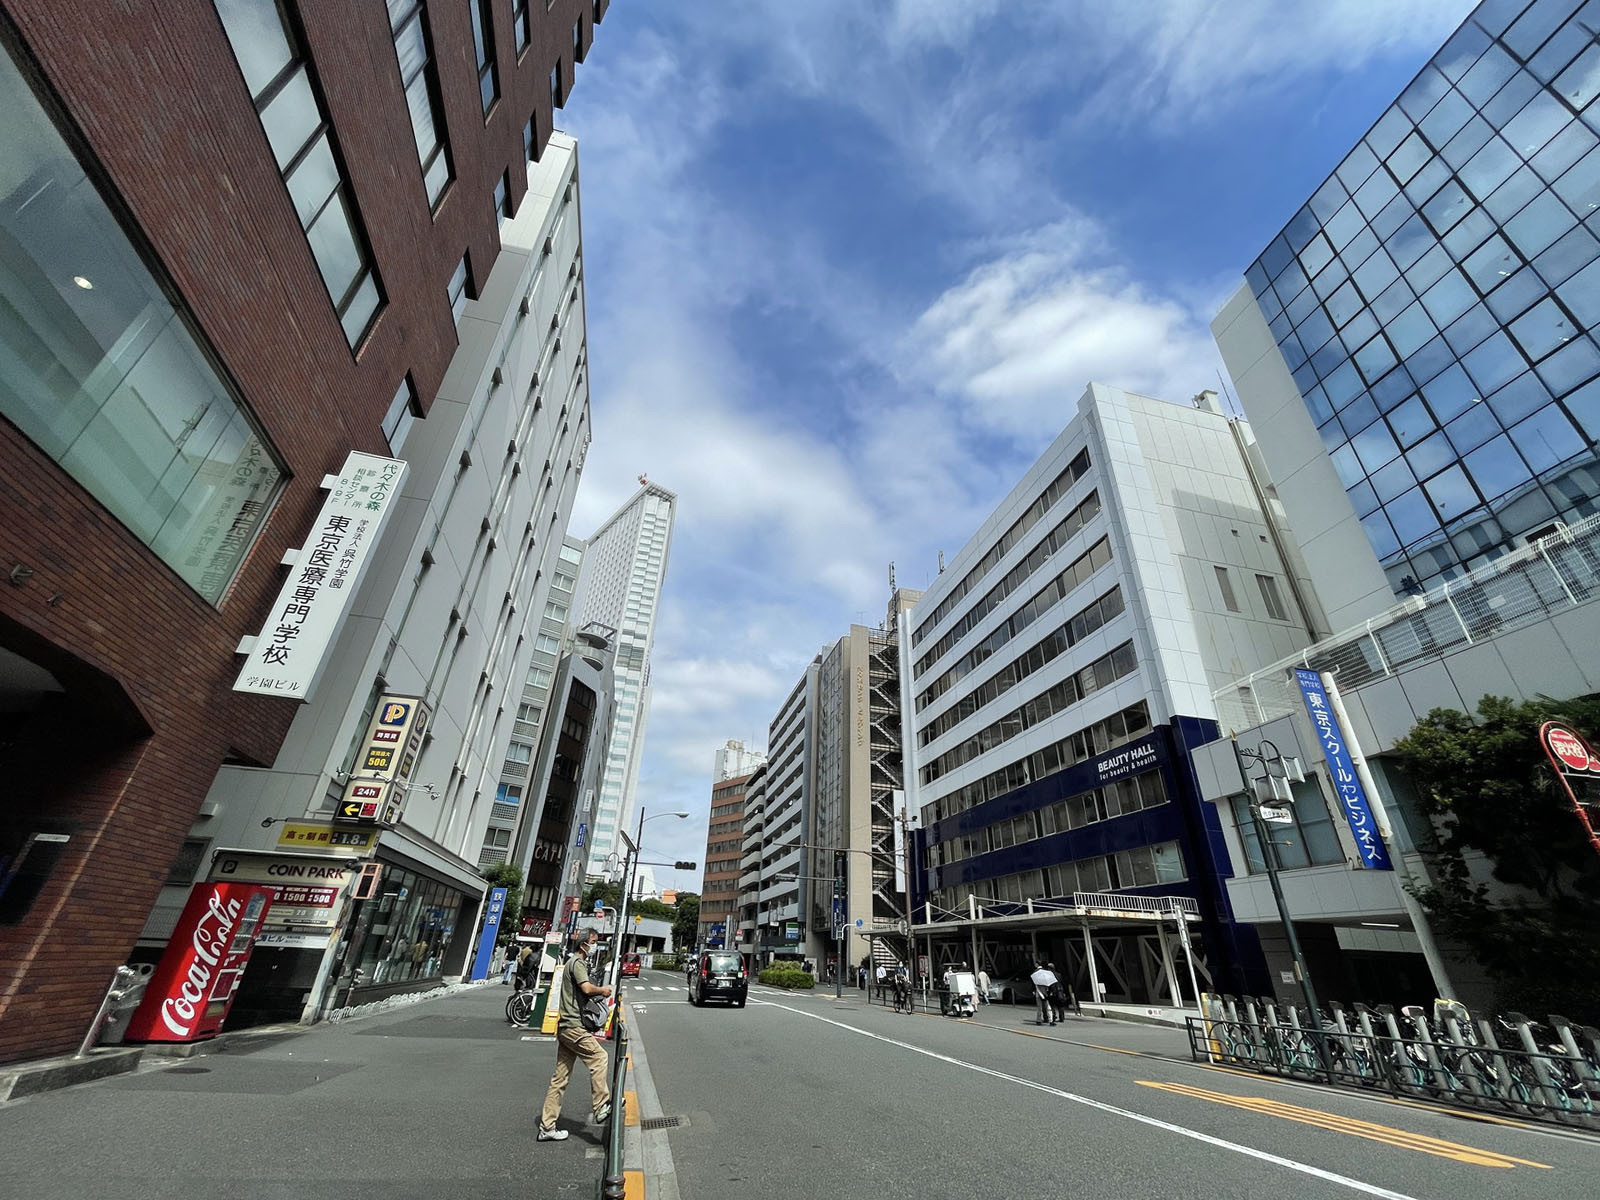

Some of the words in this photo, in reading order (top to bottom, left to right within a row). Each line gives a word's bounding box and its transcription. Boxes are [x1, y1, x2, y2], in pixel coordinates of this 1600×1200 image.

[365, 463, 398, 512] 代々木の森
[262, 514, 353, 666] 東京医療専門学校
[246, 676, 300, 692] 学園ビル
[384, 704, 405, 723] P
[1097, 752, 1129, 773] BEAUTY
[1130, 743, 1155, 760] HALL
[1109, 765, 1130, 777] beauty
[1136, 754, 1157, 768] health
[356, 787, 376, 797] 24h
[285, 830, 329, 841] 高さ制限
[267, 864, 303, 877] COIN
[307, 865, 344, 879] PARK
